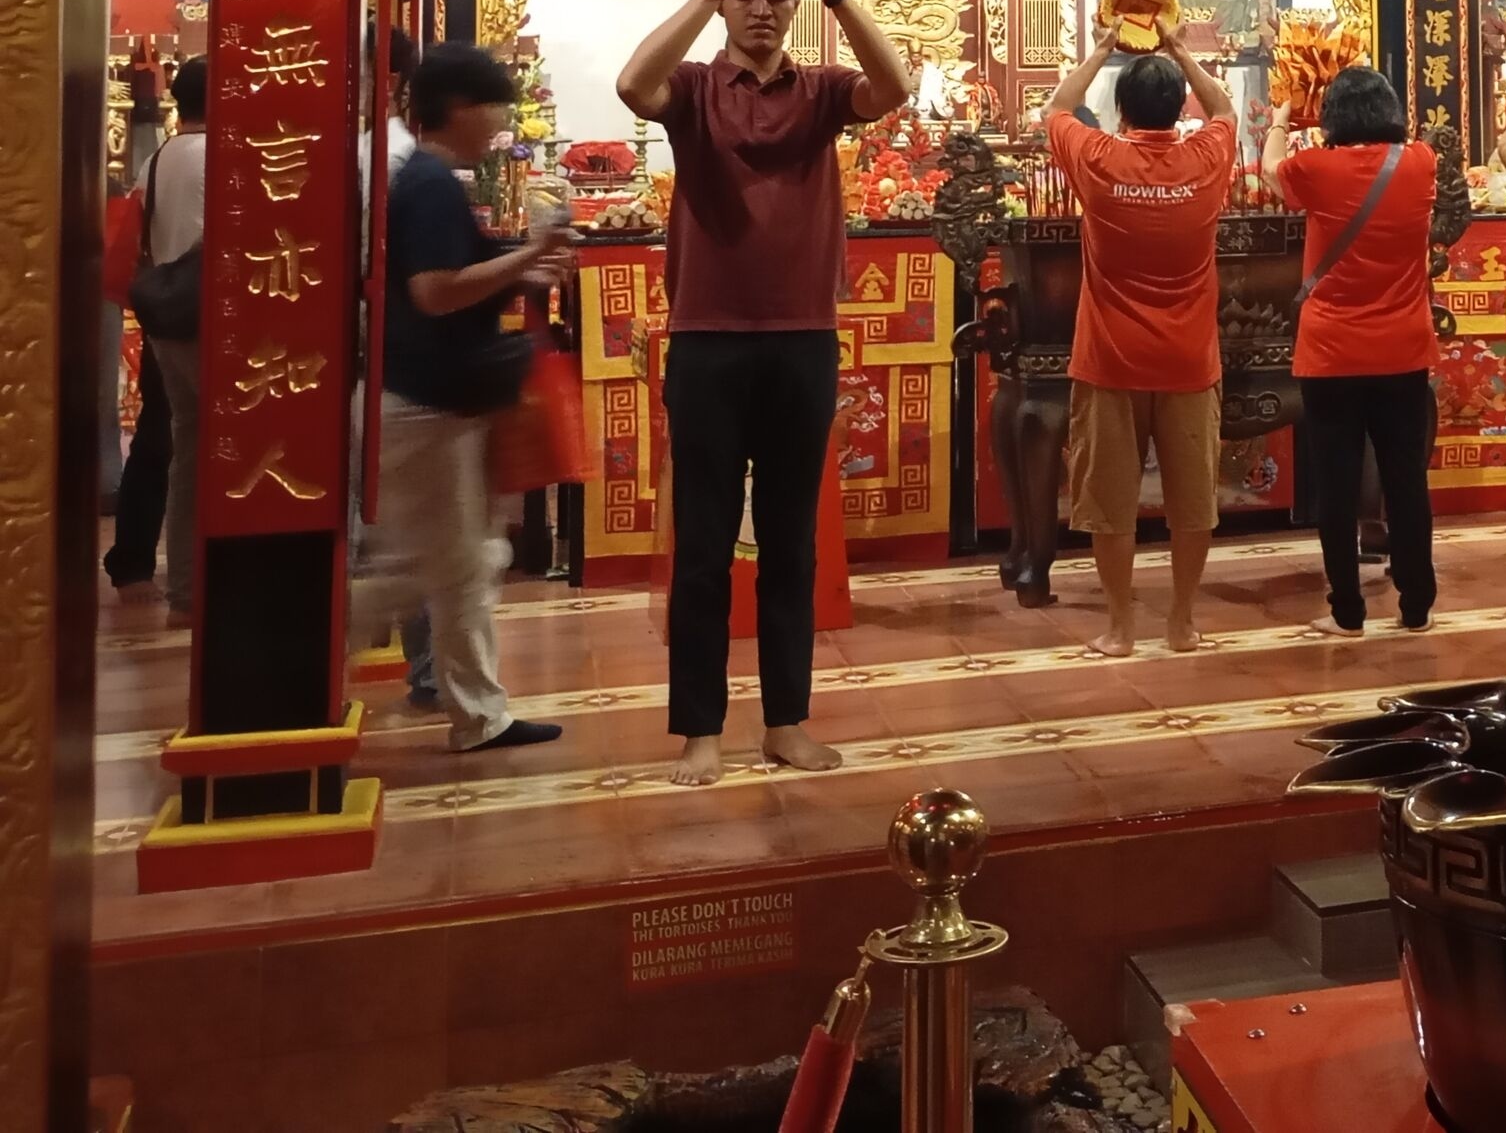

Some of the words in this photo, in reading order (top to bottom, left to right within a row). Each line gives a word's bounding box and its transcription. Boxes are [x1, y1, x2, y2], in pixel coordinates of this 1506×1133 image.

[632, 905, 688, 929] PLEASE
[693, 898, 739, 920] DON'T
[743, 892, 793, 913] TOUCH
[632, 929, 654, 944] THE
[658, 918, 721, 940] TORTOISES
[727, 915, 767, 931] THANK
[770, 910, 793, 925] YOU
[632, 942, 707, 967] DILARANG
[710, 931, 793, 956] MEMEGANG
